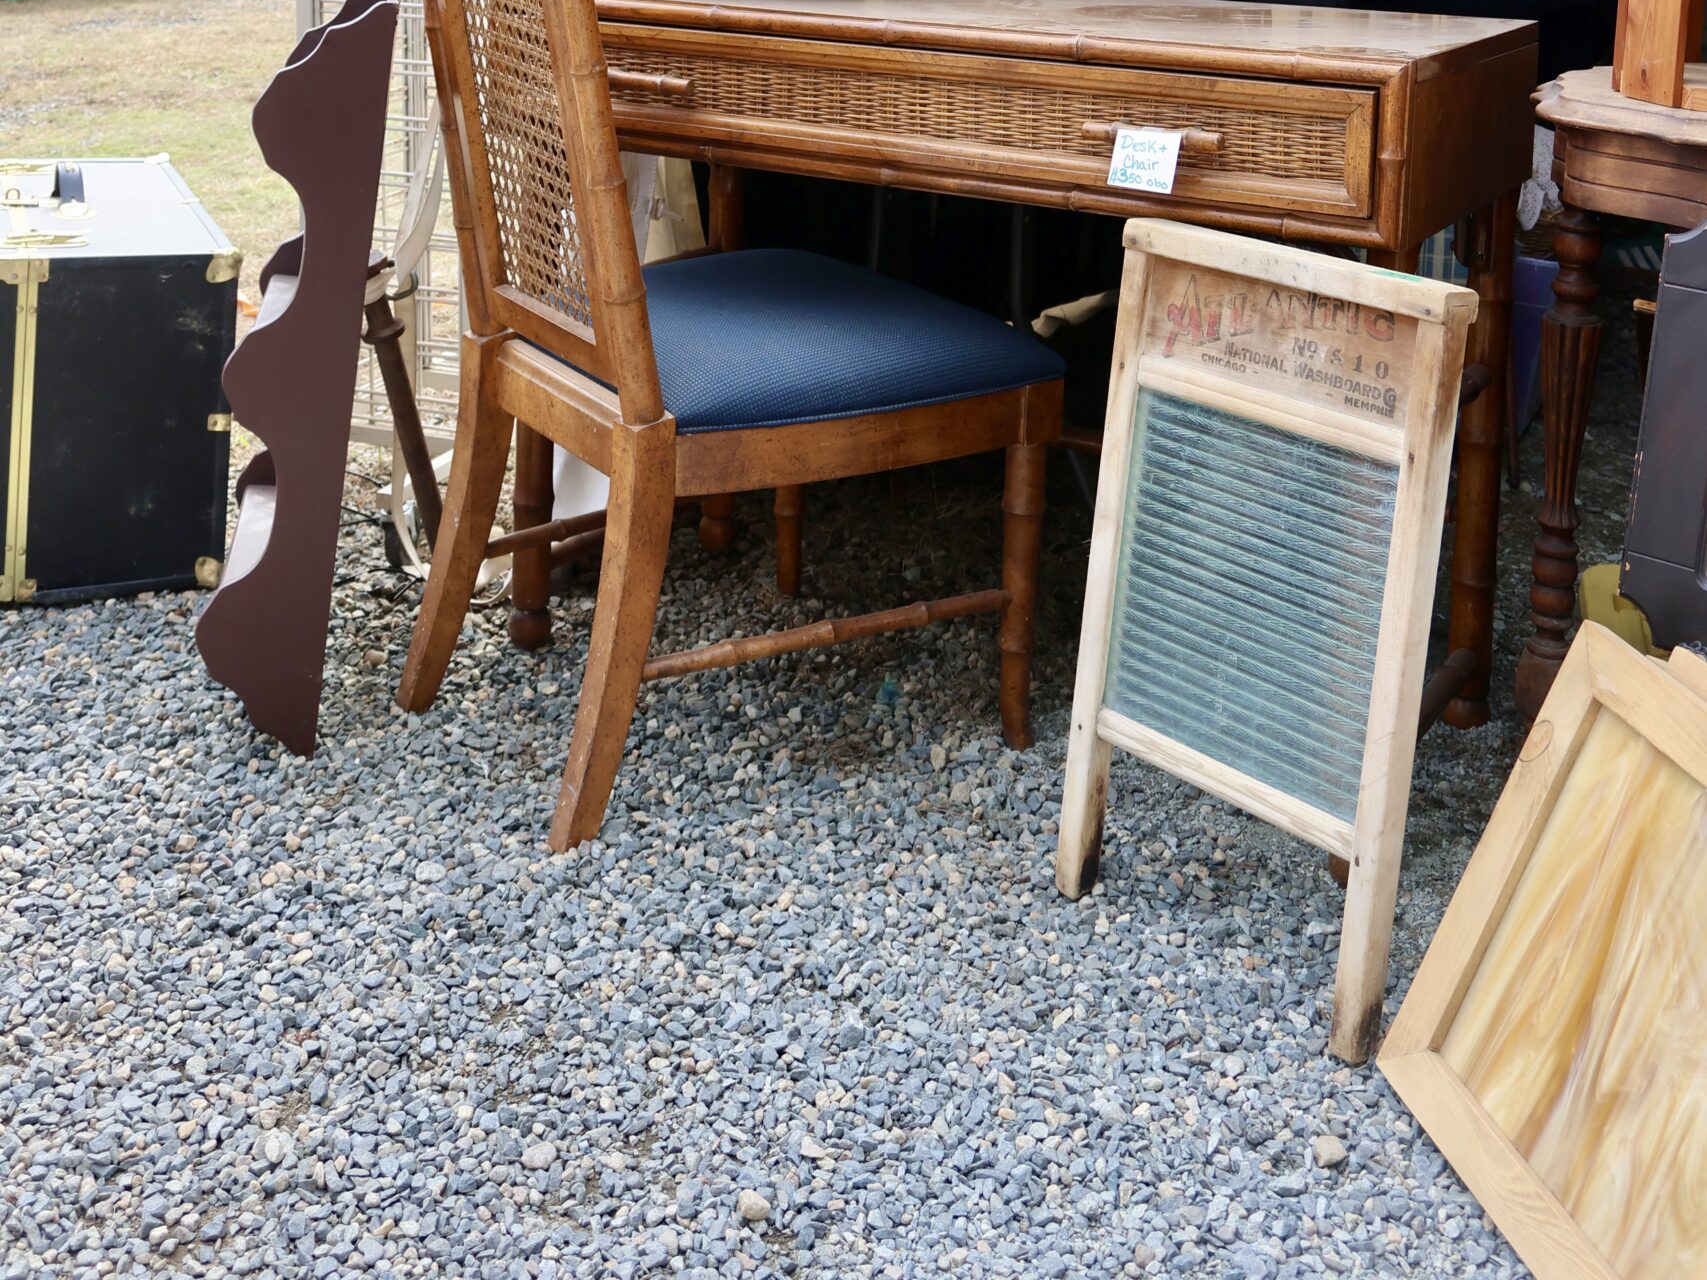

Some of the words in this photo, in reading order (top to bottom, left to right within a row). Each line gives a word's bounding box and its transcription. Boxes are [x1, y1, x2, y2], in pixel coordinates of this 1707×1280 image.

[1123, 154, 1159, 171] Chair
[1146, 178, 1168, 190] obo
[1201, 352, 1247, 374] CHICAGO
[1224, 341, 1288, 373] NATIONAL
[1293, 360, 1382, 400] WASHBOARD
